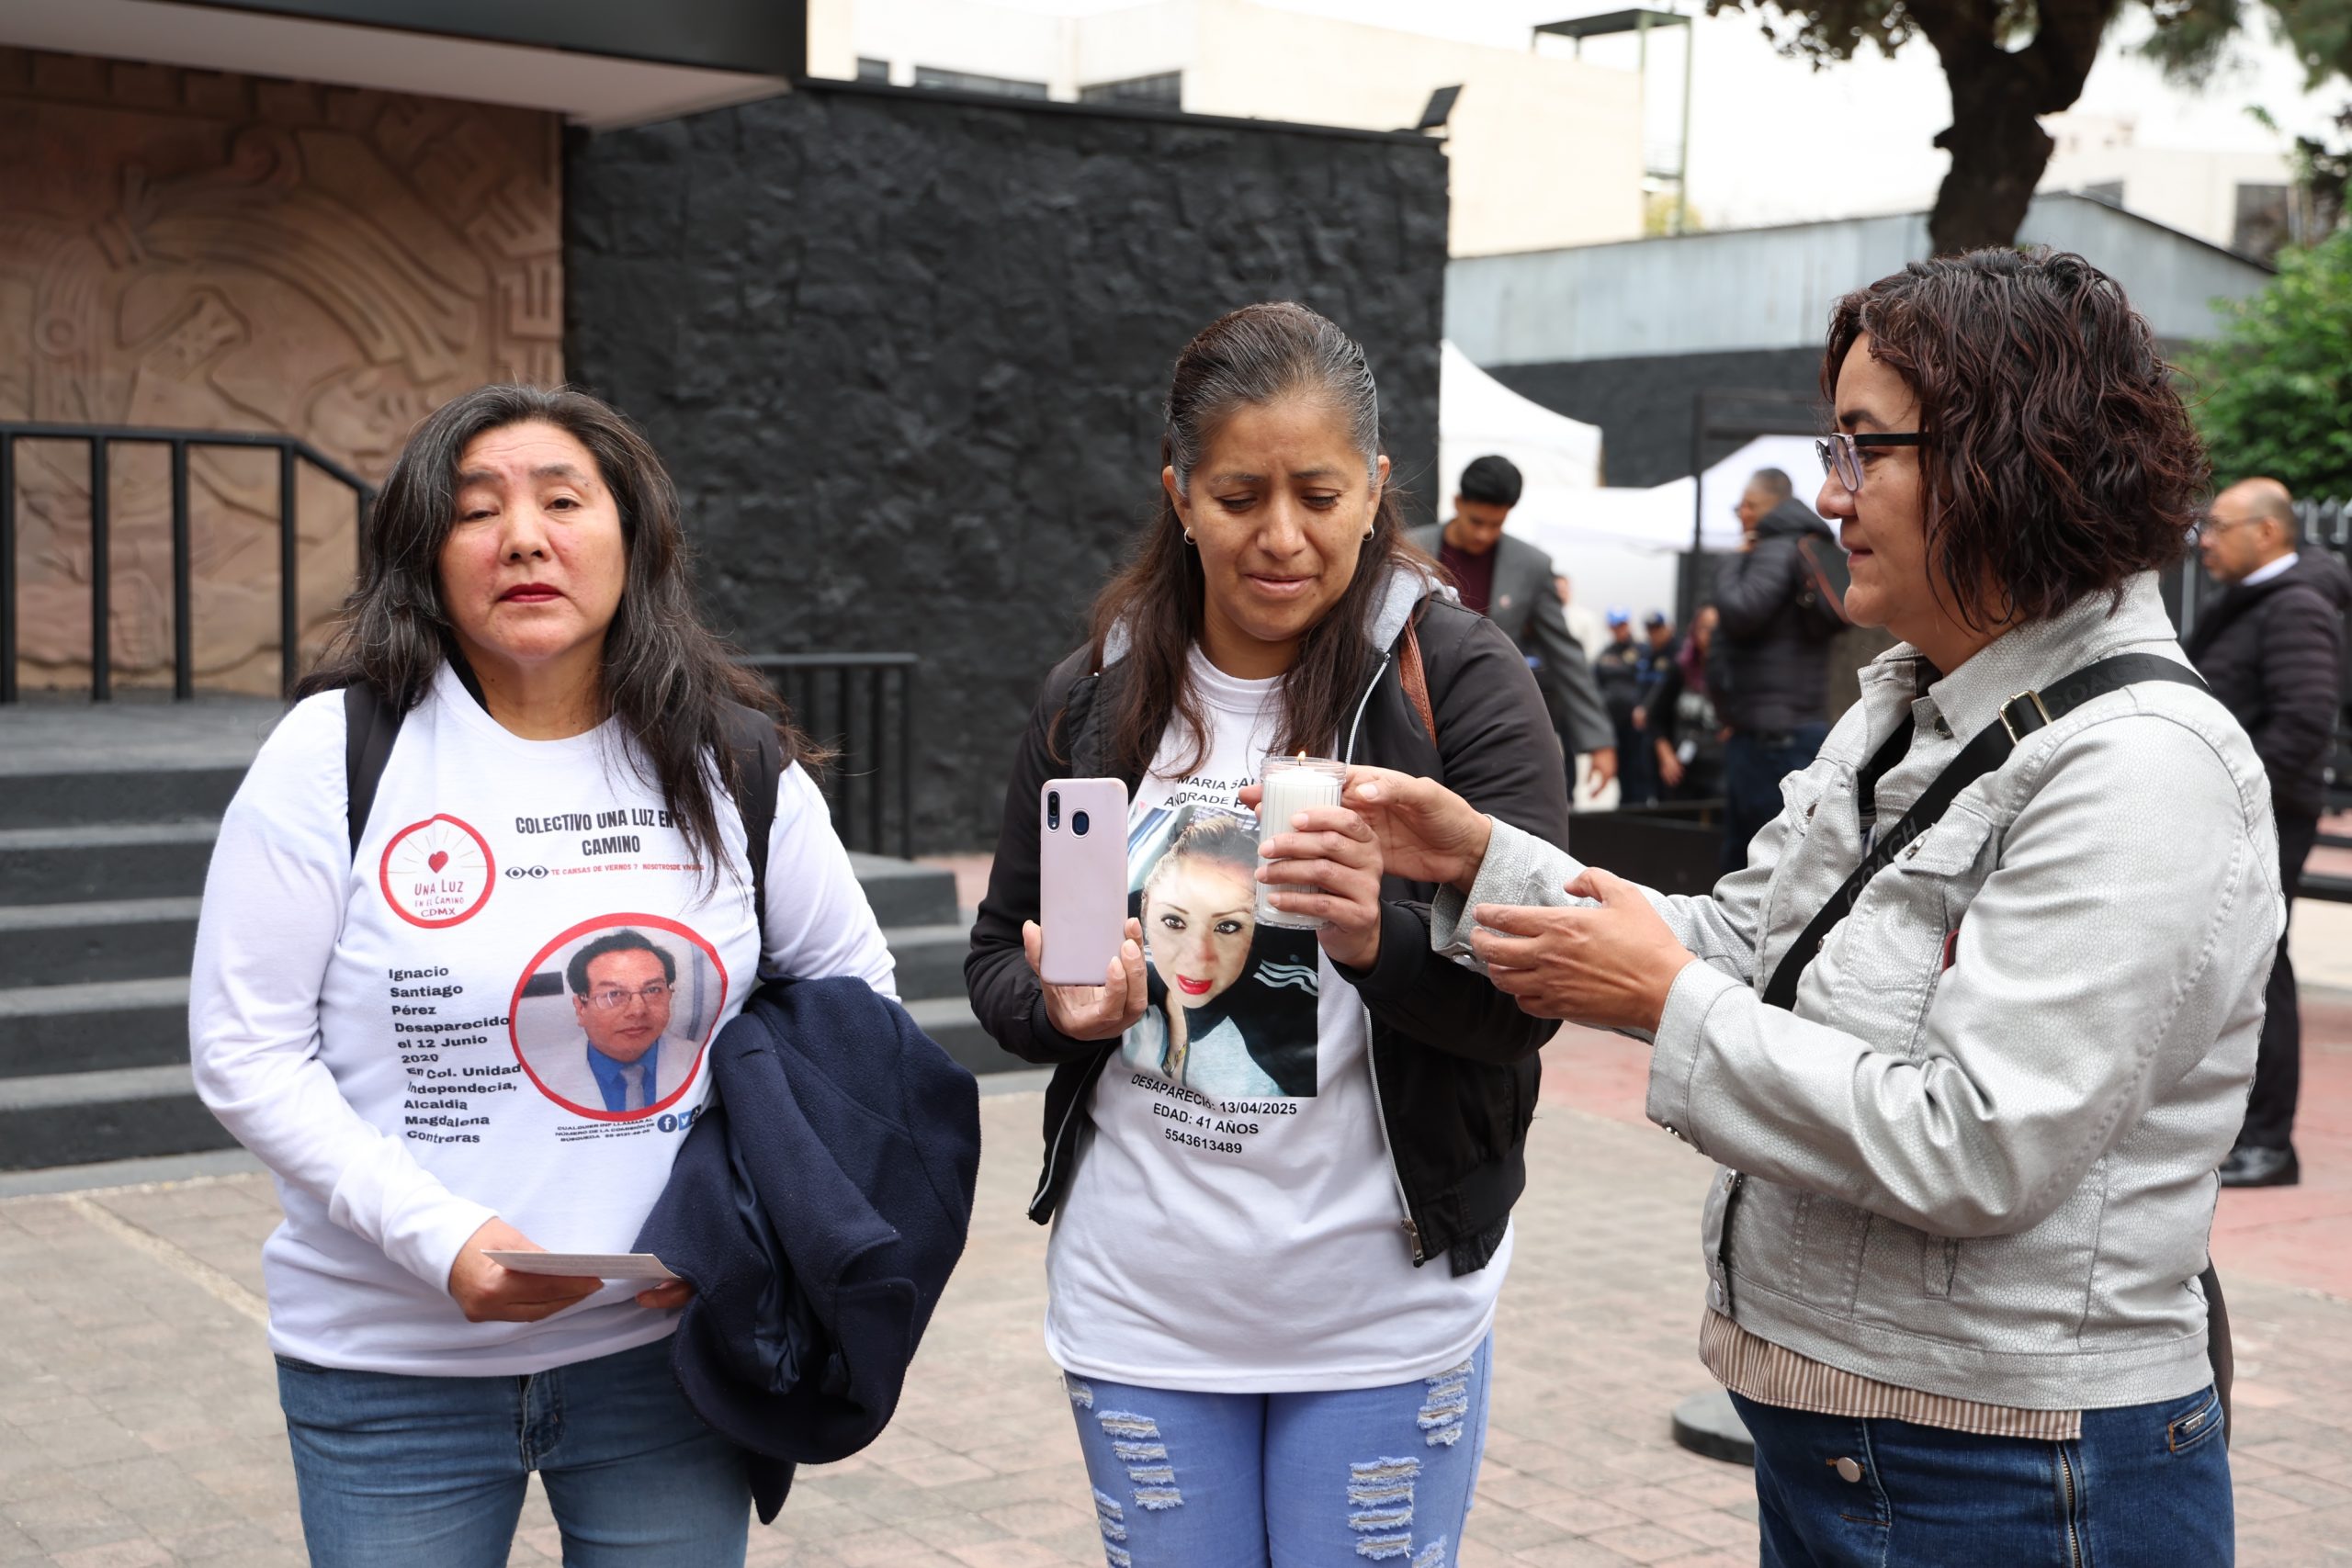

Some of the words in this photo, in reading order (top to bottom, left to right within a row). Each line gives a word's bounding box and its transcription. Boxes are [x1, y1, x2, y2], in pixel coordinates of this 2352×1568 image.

[1177, 775, 1227, 791] MARIA
[1163, 792, 1230, 807] ANDRADE
[515, 813, 593, 834] COLECTIVO
[596, 809, 628, 829] UNA
[631, 807, 655, 827] LUZ
[658, 809, 673, 829] EN
[582, 835, 640, 856] CAMINO
[550, 868, 560, 876] TE
[562, 866, 592, 875] CANSAS
[593, 864, 603, 873] DE
[605, 863, 632, 873] VERNOS
[414, 882, 435, 897] UNA
[441, 878, 464, 893] LUZ
[435, 896, 465, 905] CAMINO
[420, 907, 457, 918] CDMX
[389, 965, 449, 982] Ignacio
[390, 985, 463, 998] Santiago
[391, 1004, 437, 1016] Pérez
[394, 1016, 510, 1034] Desaparecido
[397, 1039, 412, 1049] el
[416, 1039, 436, 1049] 12
[441, 1035, 488, 1048] Junio
[401, 1054, 439, 1064] 2020
[406, 1067, 424, 1077] En
[426, 1067, 457, 1079] Col.
[462, 1064, 522, 1077] Unidad
[407, 1081, 517, 1095] Independecia,
[1219, 1101, 1297, 1115] 13/04/2025
[404, 1115, 491, 1127] Magdalena
[1153, 1102, 1193, 1124] EDAD:
[1196, 1116, 1211, 1129] 41
[1215, 1120, 1259, 1134] AÑOS
[406, 1131, 481, 1144] Contreras
[1165, 1128, 1242, 1154] 5543613489
